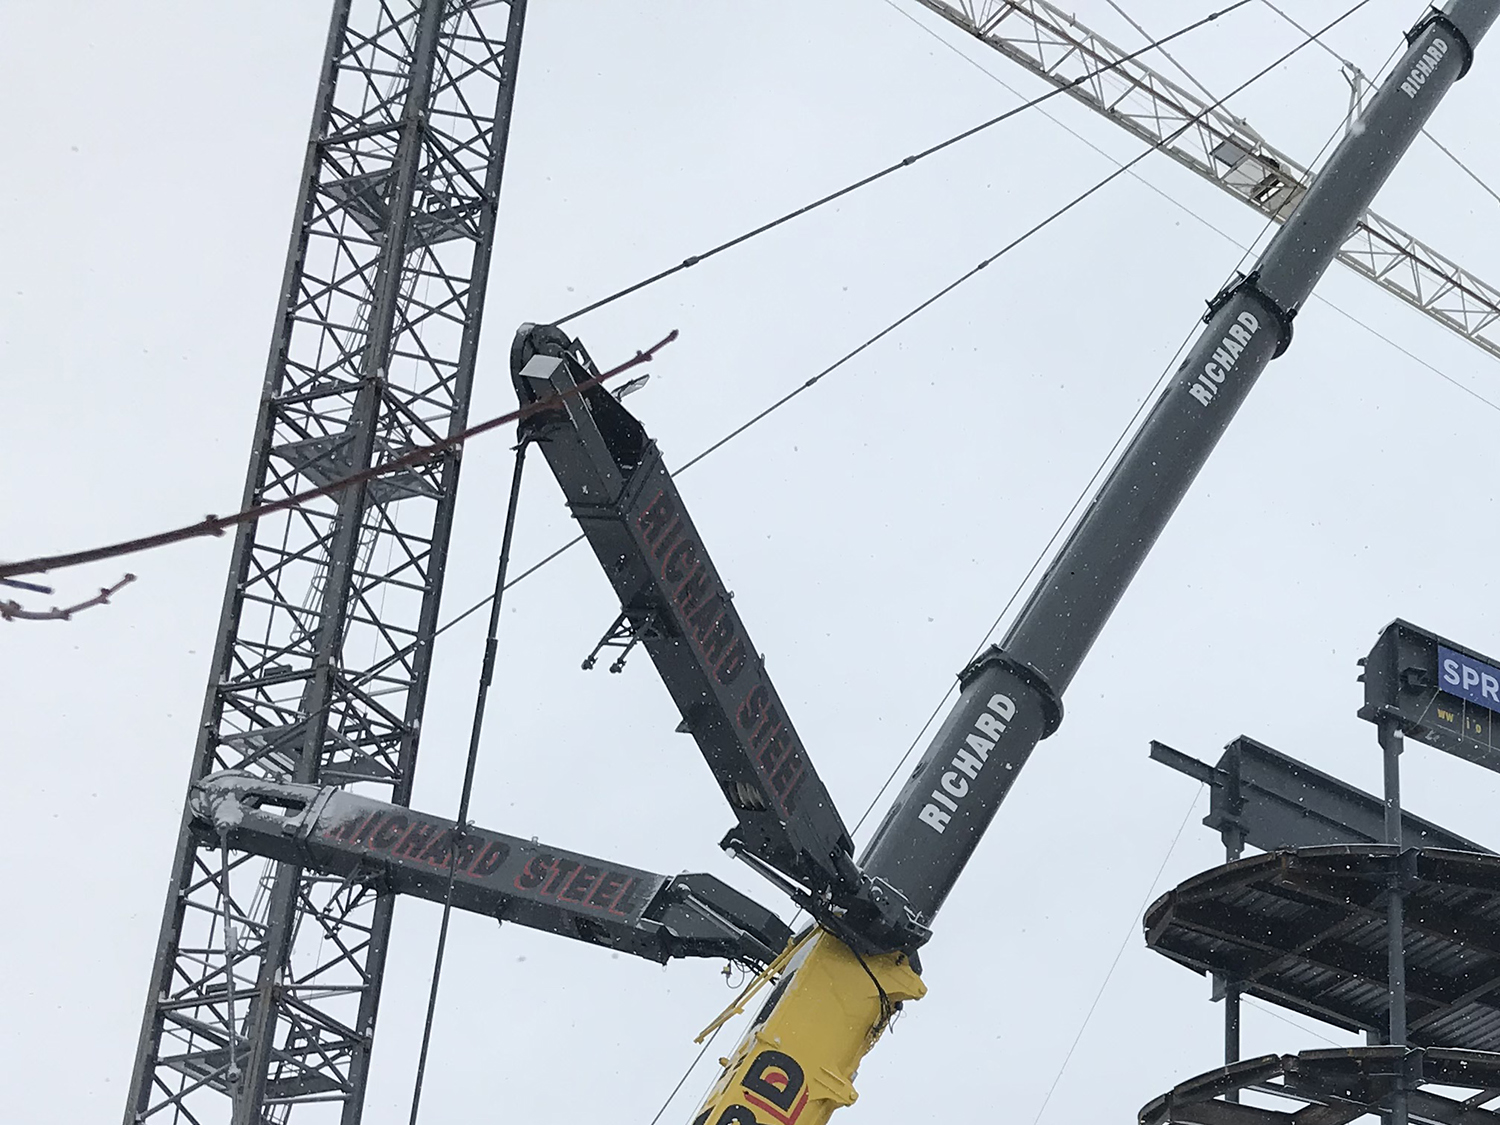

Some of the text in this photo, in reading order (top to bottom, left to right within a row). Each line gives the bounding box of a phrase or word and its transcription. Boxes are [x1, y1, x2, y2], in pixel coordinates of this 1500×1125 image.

[1400, 38, 1448, 98] RICHARD
[1189, 311, 1259, 407] RICHARD
[636, 489, 806, 818] RICHARD STEEL
[918, 693, 1016, 834] RICHARD
[514, 854, 644, 917] STEEL
